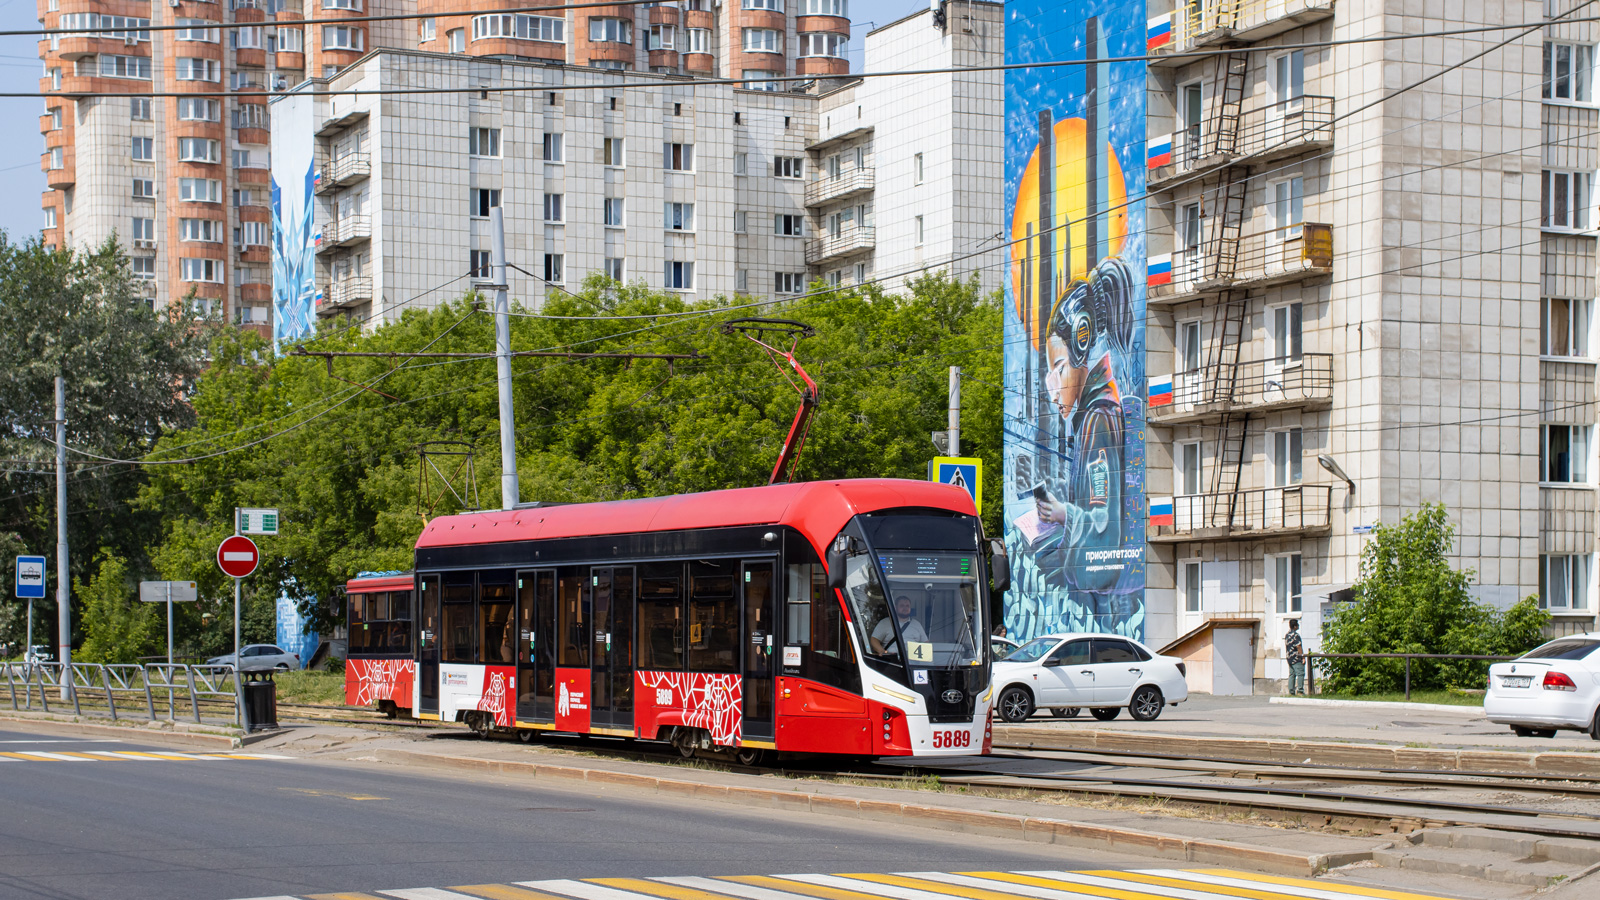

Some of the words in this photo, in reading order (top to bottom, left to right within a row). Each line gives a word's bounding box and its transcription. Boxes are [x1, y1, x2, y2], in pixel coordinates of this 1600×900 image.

[913, 644, 924, 659] 4
[656, 688, 673, 706] 5889
[932, 729, 970, 749] 5889
